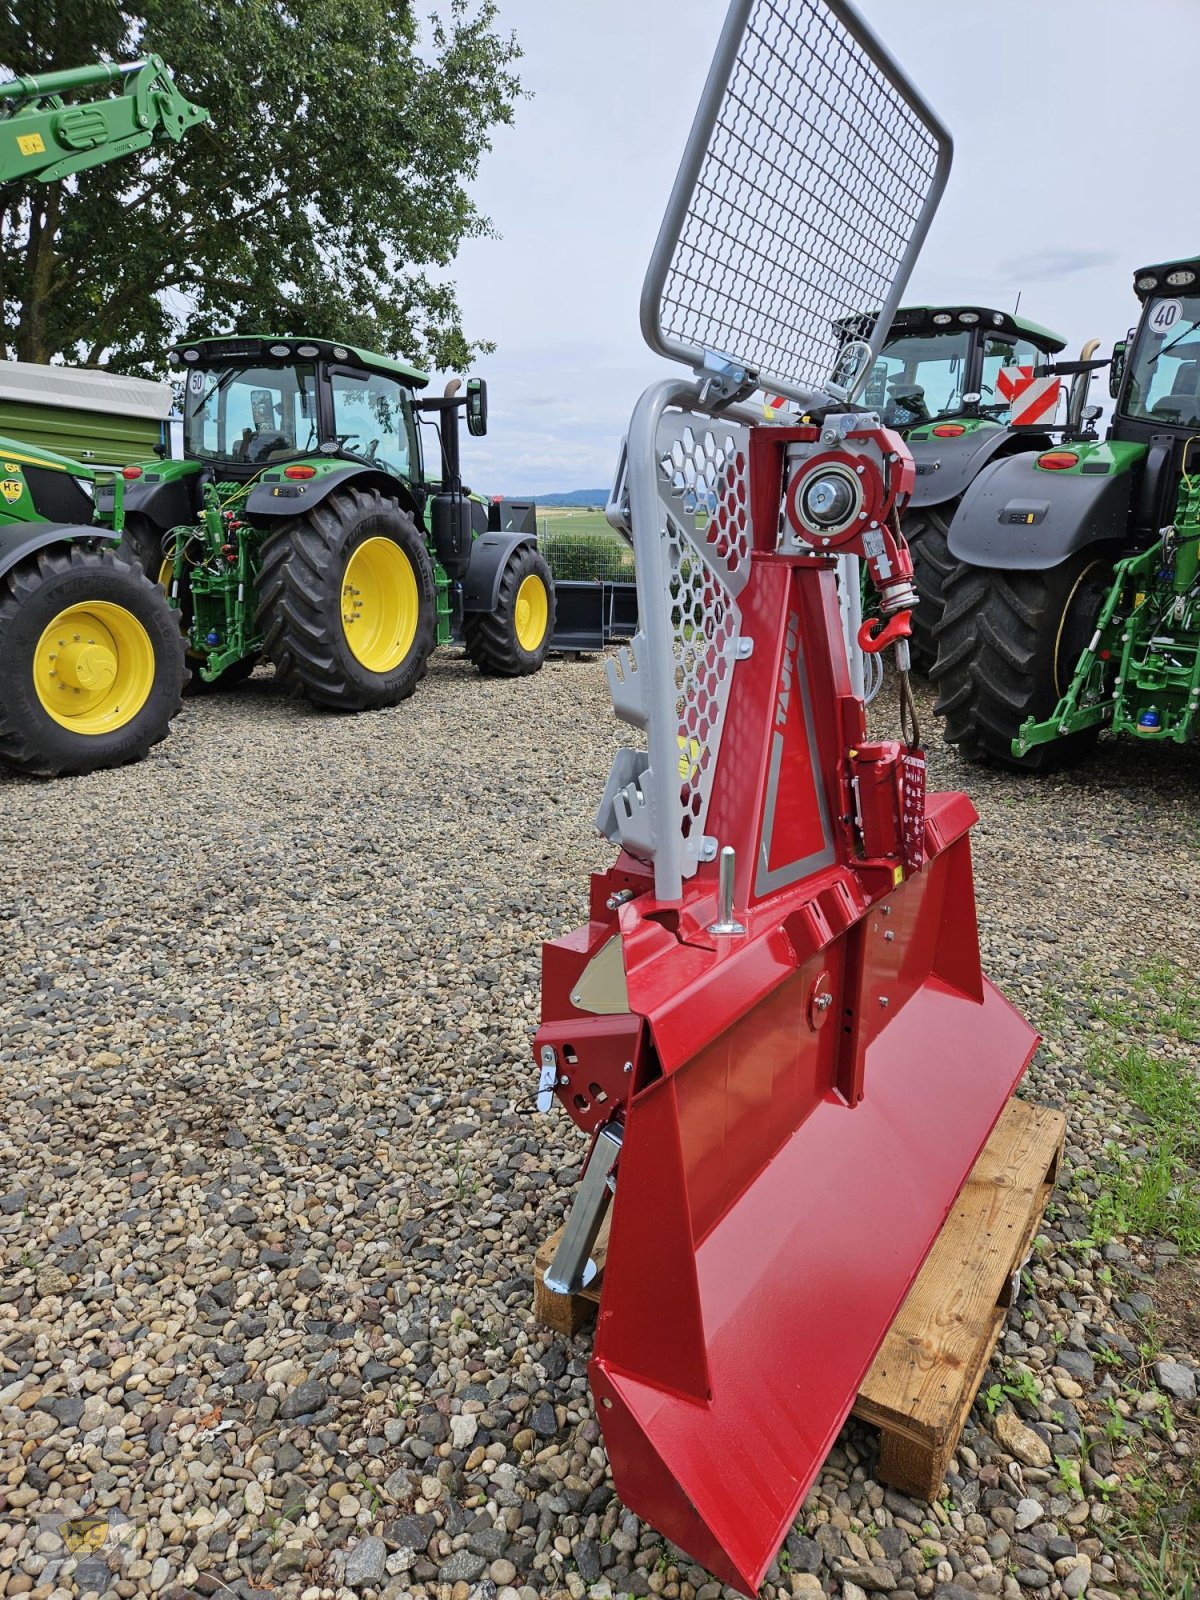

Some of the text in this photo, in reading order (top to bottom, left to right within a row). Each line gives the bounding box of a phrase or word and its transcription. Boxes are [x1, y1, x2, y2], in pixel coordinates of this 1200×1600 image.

[1154, 305, 1177, 326] 40
[192, 374, 202, 390] 50
[5, 463, 21, 473] 6R
[775, 609, 799, 726] TAJFUN
